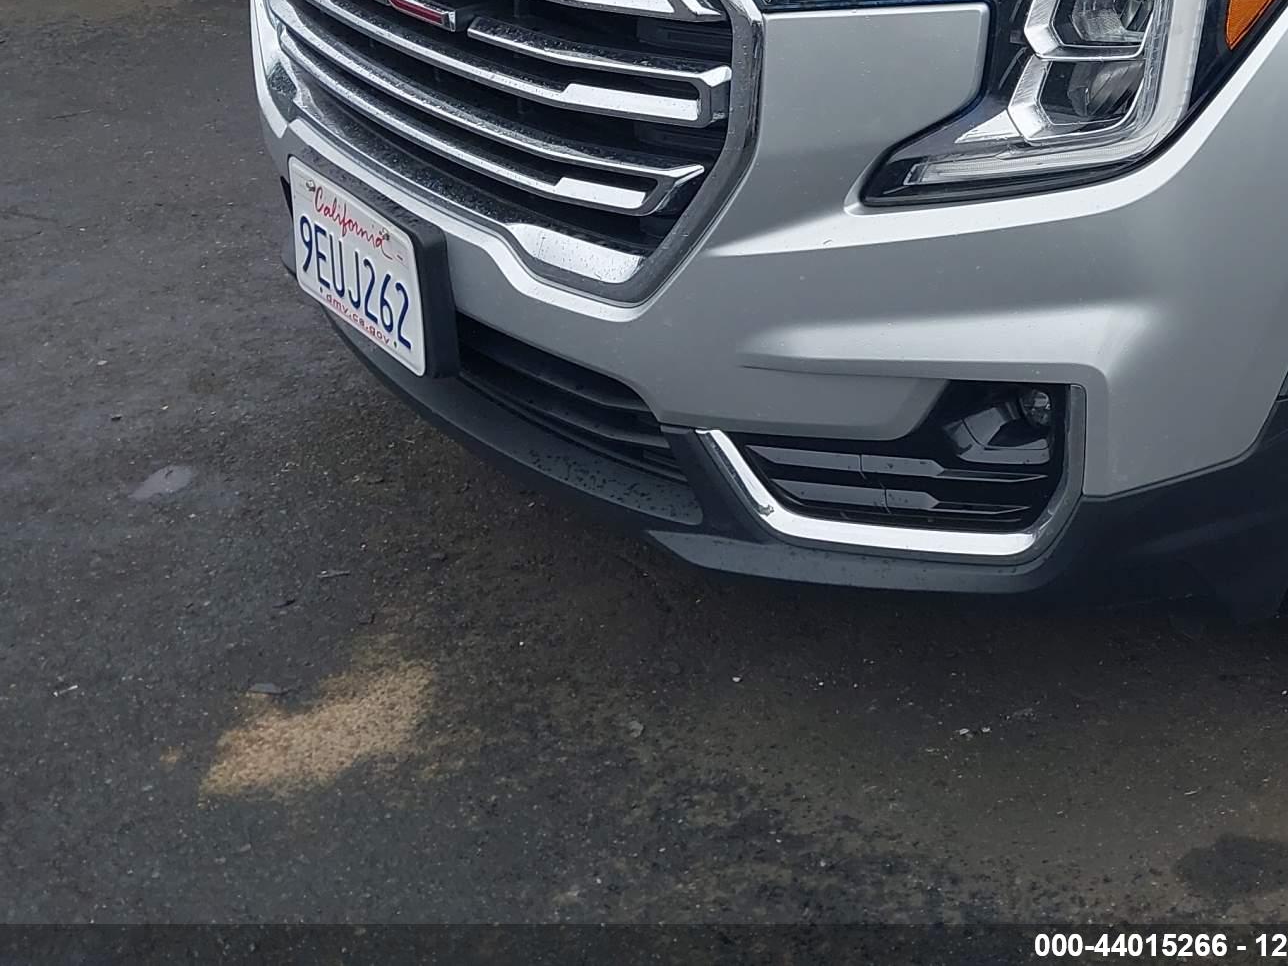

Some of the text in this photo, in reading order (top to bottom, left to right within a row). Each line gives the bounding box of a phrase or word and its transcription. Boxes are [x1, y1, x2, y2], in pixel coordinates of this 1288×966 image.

[314, 186, 393, 260] California
[300, 215, 412, 352] 9EUJ262
[326, 293, 390, 346] dmv.ca.gov
